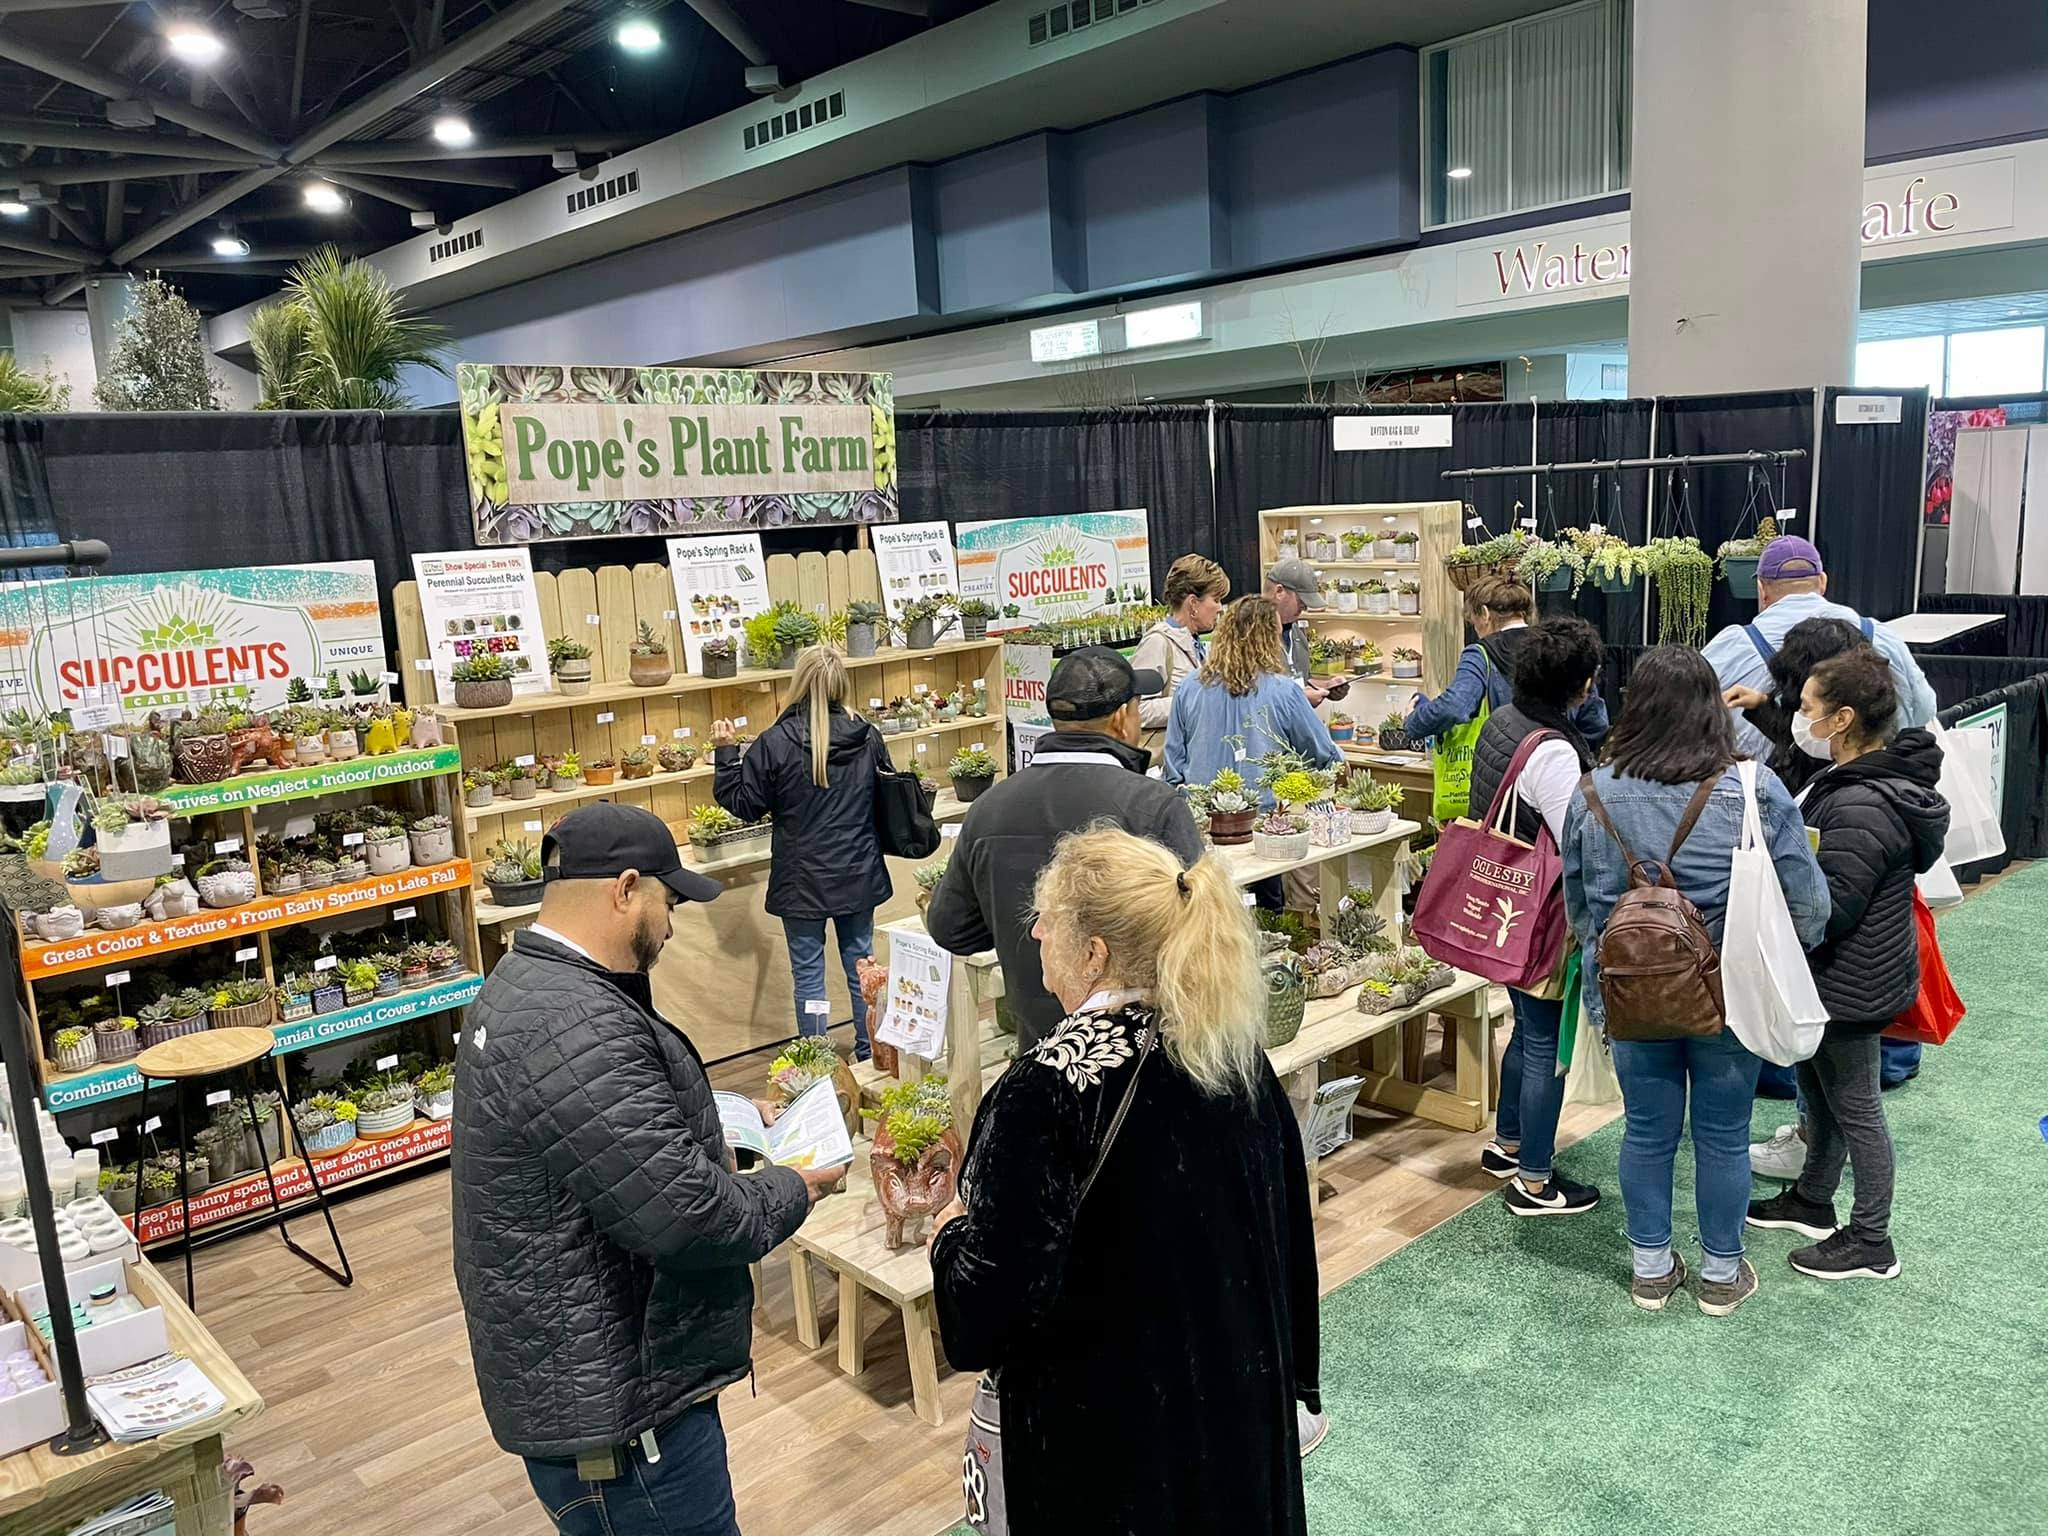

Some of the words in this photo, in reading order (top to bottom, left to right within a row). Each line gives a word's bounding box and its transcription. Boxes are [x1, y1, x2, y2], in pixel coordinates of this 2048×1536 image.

[1861, 177, 1960, 243] afe
[512, 416, 660, 491] Pope's
[669, 416, 772, 476] Plant
[780, 416, 869, 474] Farm
[676, 546, 702, 560] Pope's
[703, 544, 728, 558] Spring
[729, 544, 748, 554] Rack
[748, 543, 756, 553] A
[902, 530, 923, 544] Spring
[922, 530, 938, 540] Rack
[427, 575, 465, 588] Perennial
[466, 574, 505, 586] Succulent
[506, 572, 526, 582] Rack
[444, 562, 463, 571] Show
[464, 561, 487, 571] Special
[492, 560, 508, 569] Save
[508, 559, 521, 568] 10%
[1008, 563, 1108, 598] SUCCULENTS
[1124, 566, 1145, 574] UNIQUE
[963, 582, 993, 592] CREATIVE
[330, 645, 374, 656] UNIQUE
[0, 678, 24, 688] IVE
[60, 642, 290, 701] SUCCULENTS
[223, 790, 246, 803] on
[247, 778, 310, 801] Neglect
[321, 758, 436, 787] Indoor/Outdoor
[1472, 858, 1534, 887] OGLESBY
[43, 945, 94, 966] Great
[96, 934, 144, 954] Color
[148, 931, 162, 944] &
[164, 916, 228, 941] Texture
[240, 905, 282, 926] From
[285, 897, 326, 917] Early
[327, 885, 378, 908] Spring
[382, 882, 394, 895] to
[398, 872, 429, 892] Late
[432, 868, 457, 884] Fall
[318, 1012, 372, 1036] Ground
[376, 1000, 417, 1020] Cover
[428, 984, 482, 1008] Accents
[132, 1210, 168, 1230] eep
[172, 1204, 184, 1216] in
[188, 1190, 230, 1212] sunny
[234, 1178, 270, 1200] spots
[274, 1169, 299, 1186] and
[341, 1146, 378, 1166] about
[380, 1138, 410, 1153] once
[412, 1132, 421, 1142] a
[149, 1226, 164, 1238] in
[192, 1200, 248, 1225] summer
[280, 1180, 314, 1197] once
[327, 1162, 368, 1183] month
[370, 1156, 382, 1170] in
[384, 1148, 404, 1162] the
[406, 1134, 448, 1158] winter!
